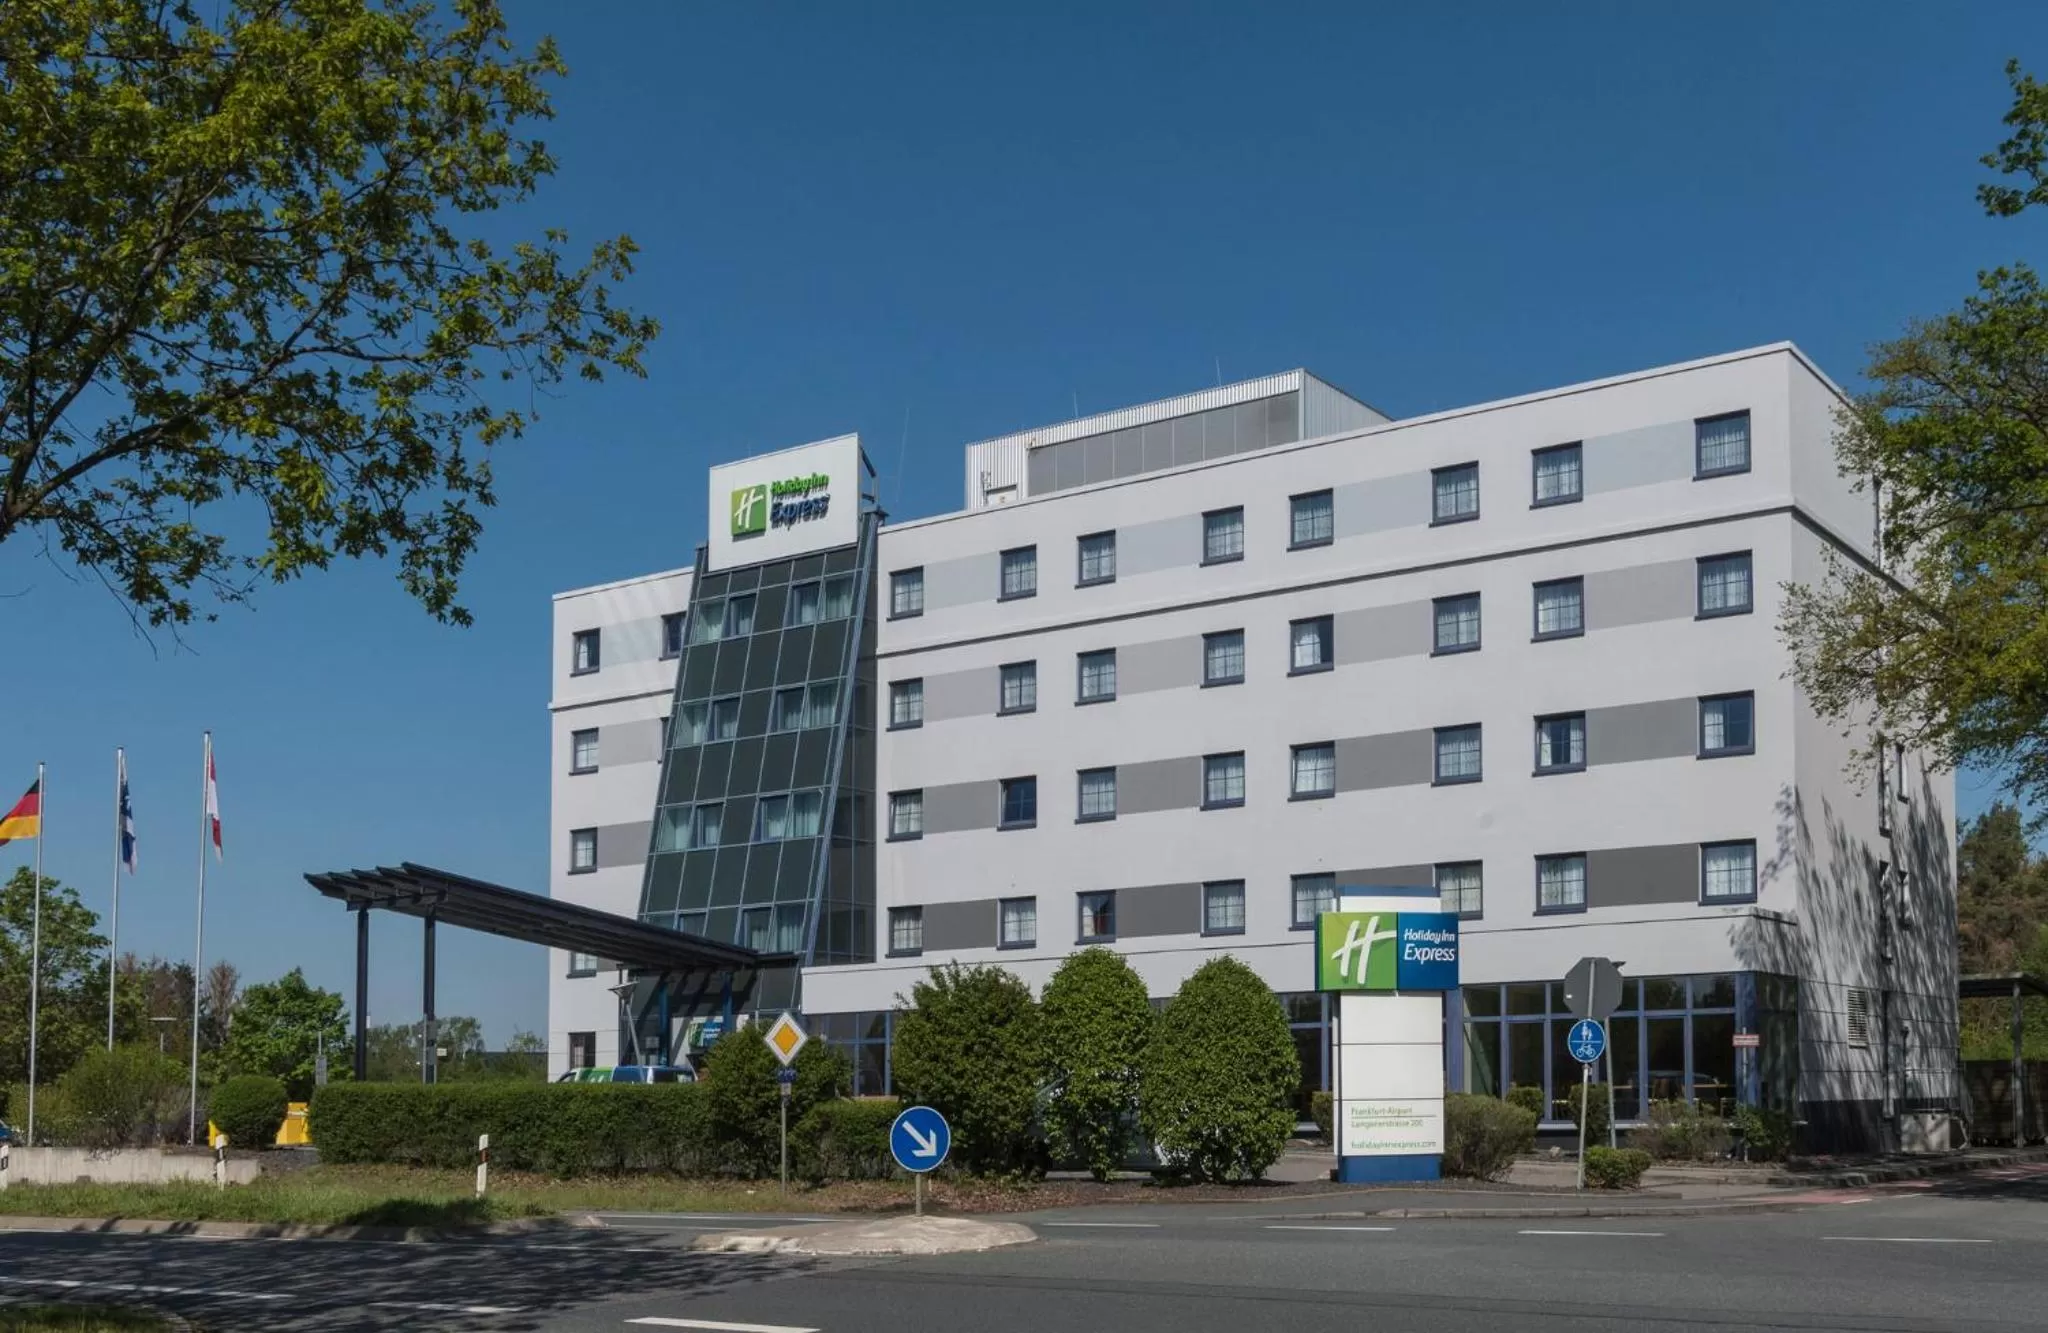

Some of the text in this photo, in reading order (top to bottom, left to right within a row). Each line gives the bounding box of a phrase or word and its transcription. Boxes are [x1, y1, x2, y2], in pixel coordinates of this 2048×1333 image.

[770, 472, 830, 498] Holiday Inn
[770, 495, 831, 530] Express
[1404, 928, 1456, 944] Holiday Inn
[1404, 943, 1456, 965] Express
